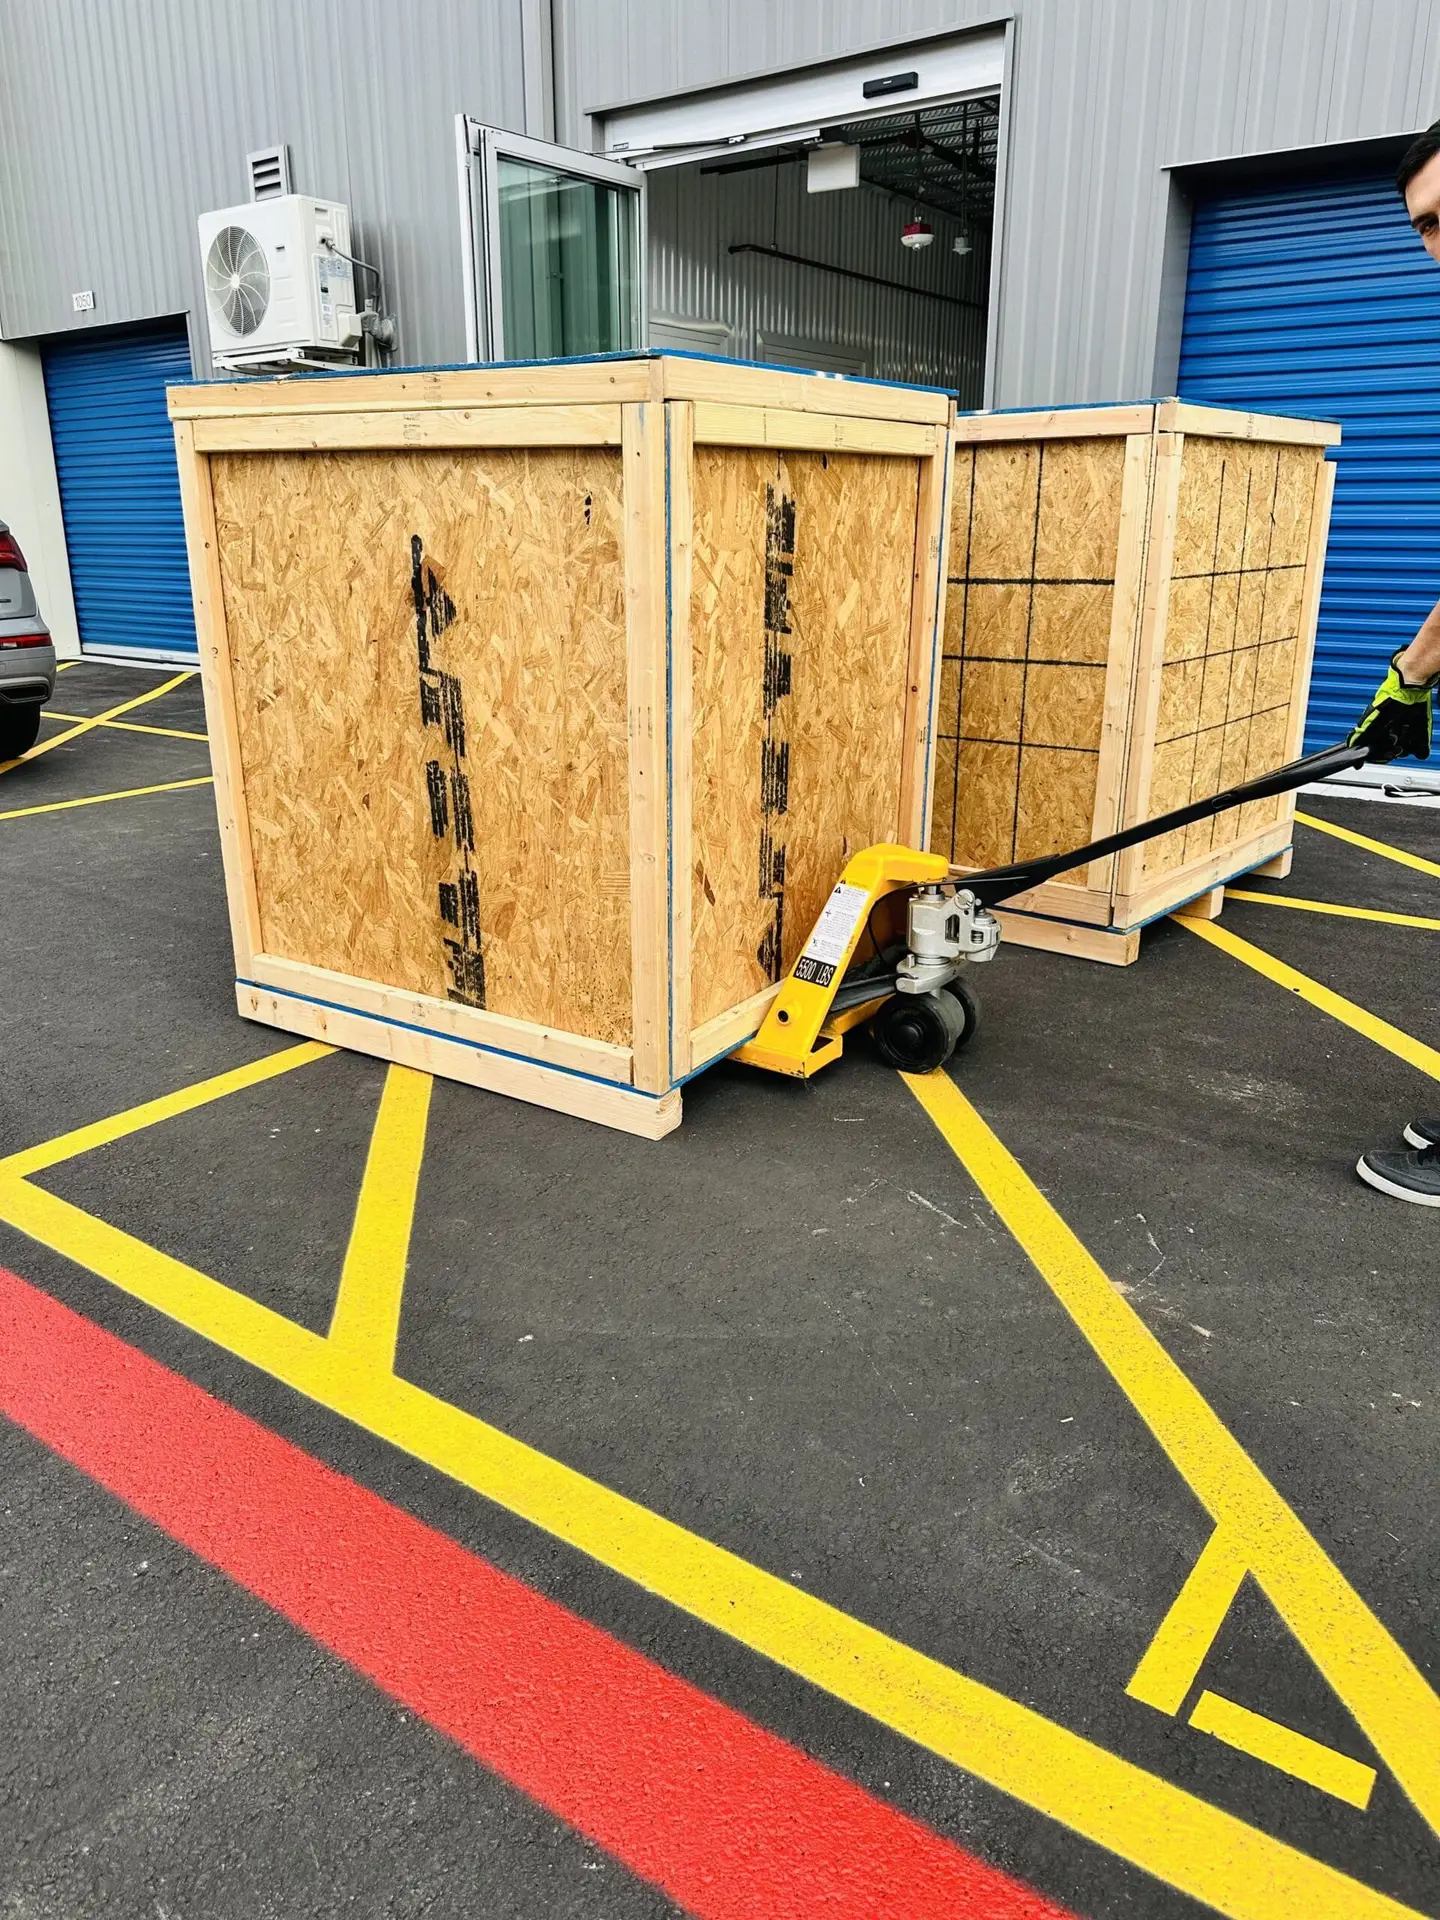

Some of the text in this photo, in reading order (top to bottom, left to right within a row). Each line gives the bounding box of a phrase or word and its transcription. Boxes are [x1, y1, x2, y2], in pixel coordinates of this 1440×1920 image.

[75, 294, 91, 308] 1050
[796, 958, 834, 986] 5500 LBS
